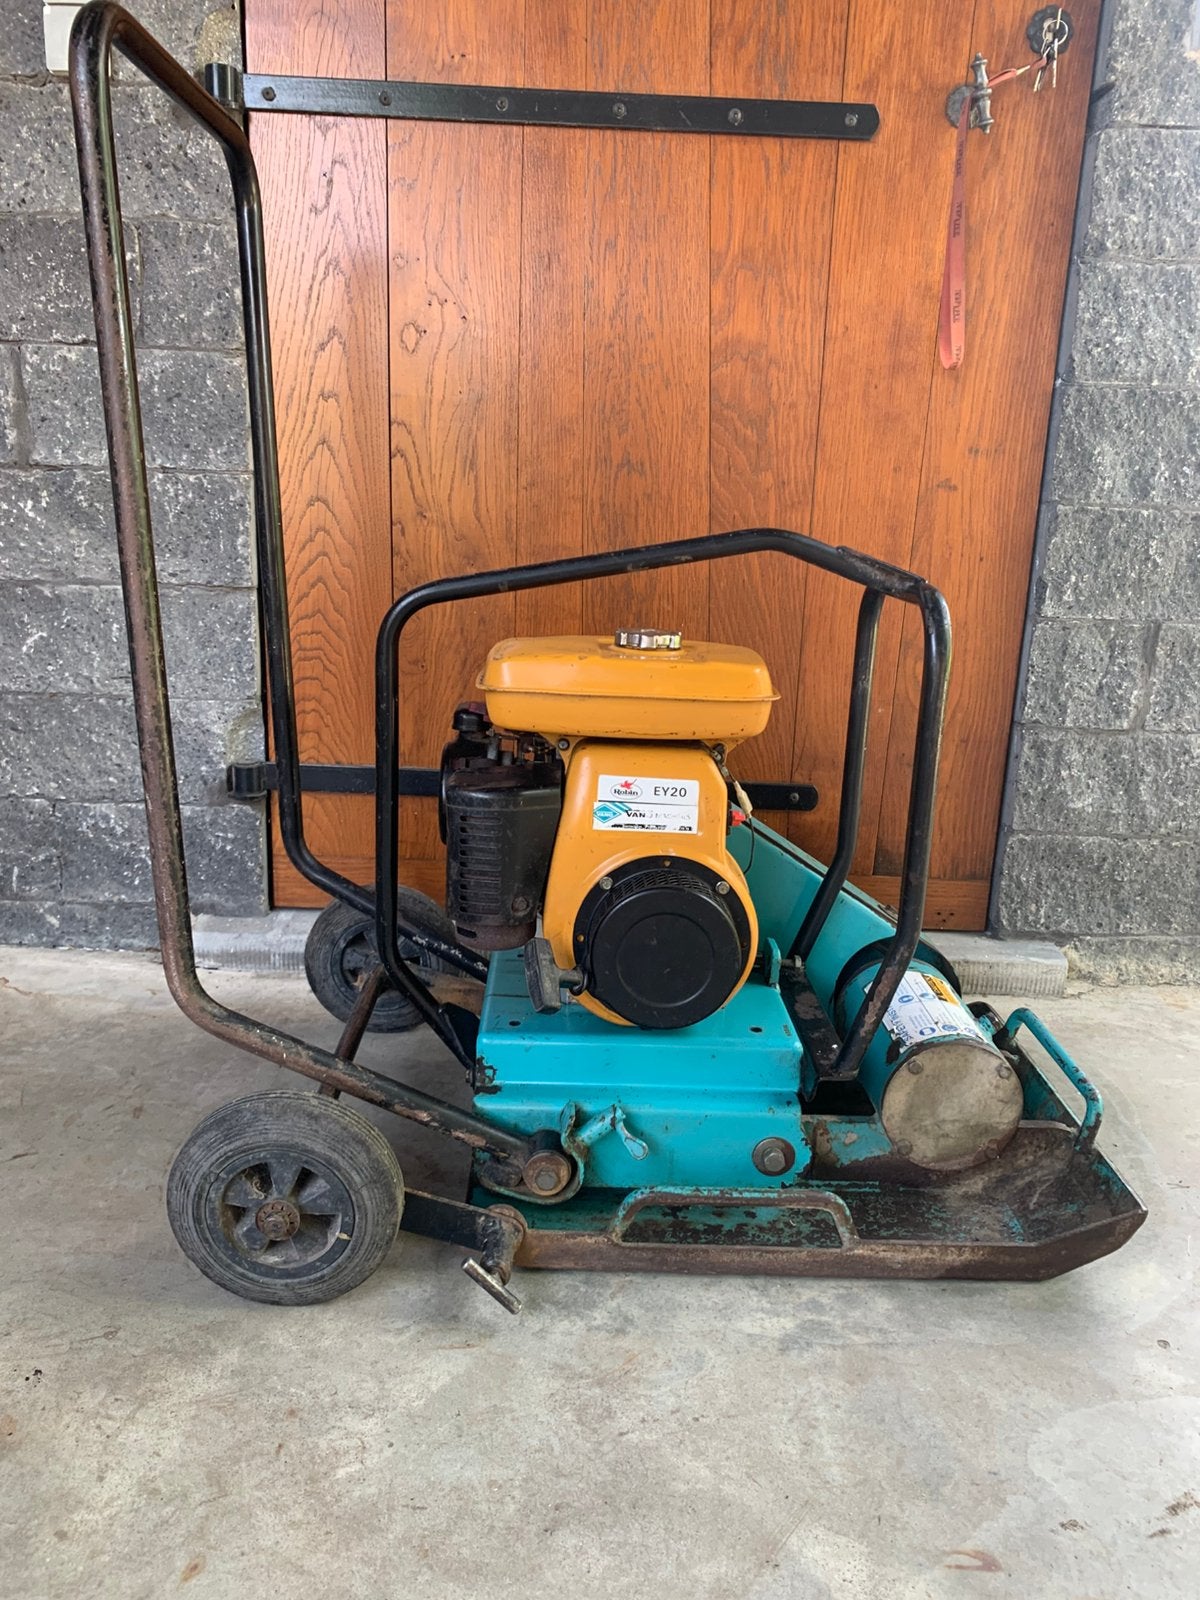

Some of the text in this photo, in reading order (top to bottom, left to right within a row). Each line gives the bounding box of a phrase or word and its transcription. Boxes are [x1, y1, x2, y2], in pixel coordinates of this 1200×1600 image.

[613, 788, 639, 796] Robin
[653, 786, 687, 797] EY20
[626, 810, 646, 818] VAN
